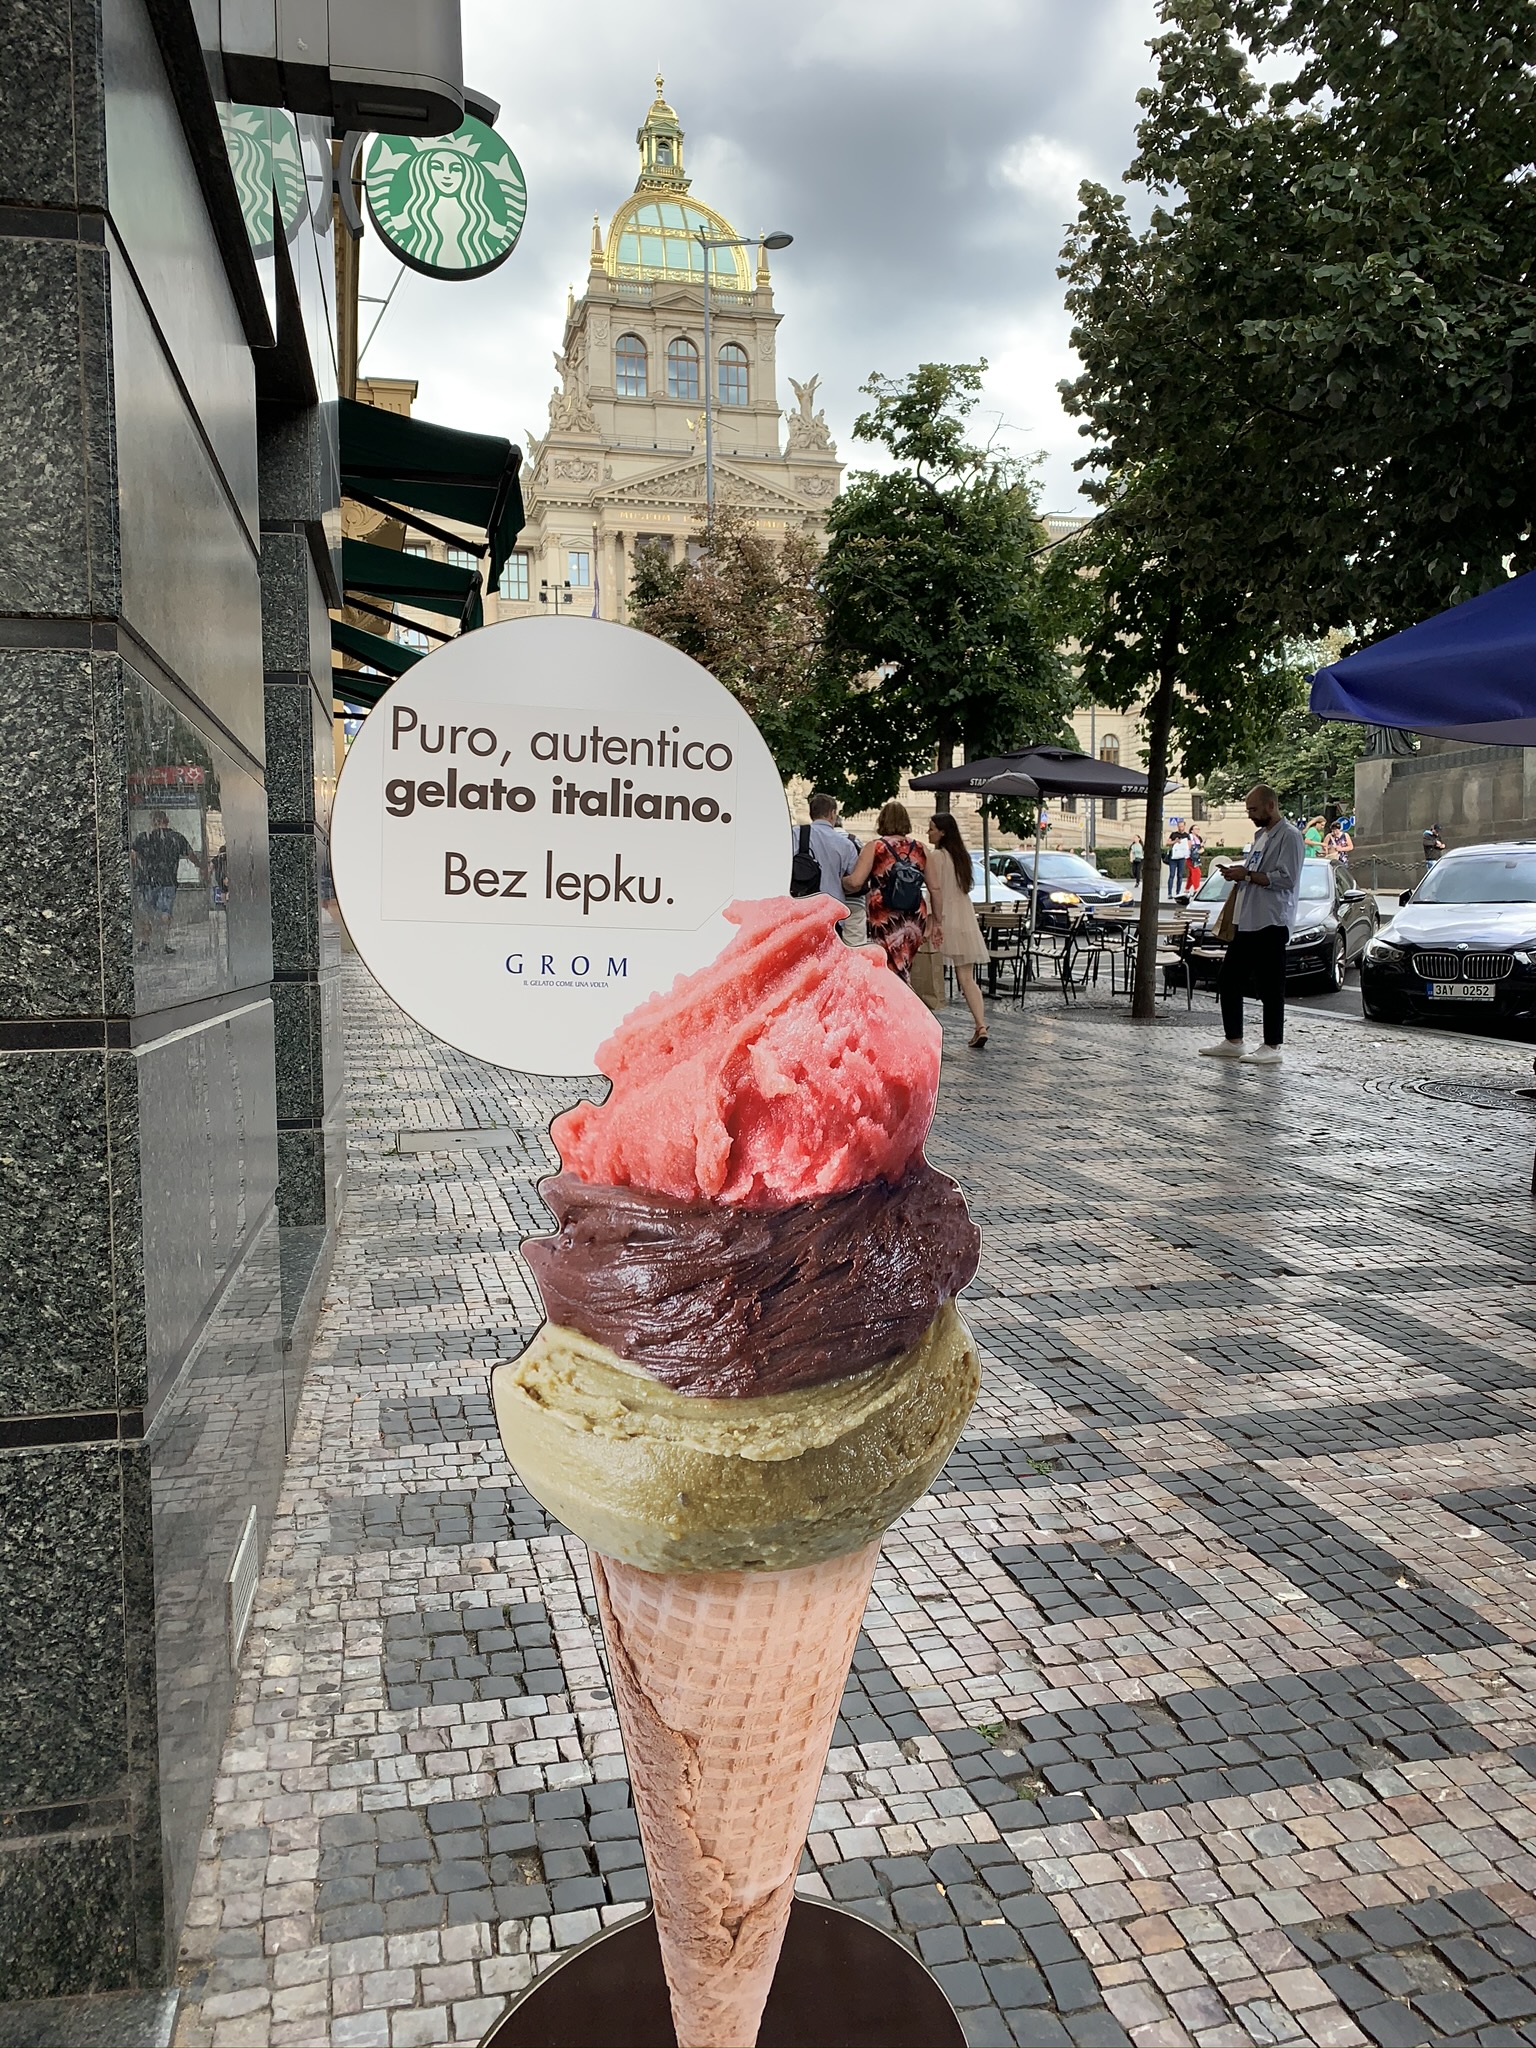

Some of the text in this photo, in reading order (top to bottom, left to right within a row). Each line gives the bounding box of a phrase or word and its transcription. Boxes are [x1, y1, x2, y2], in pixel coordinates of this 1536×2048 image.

[391, 705, 734, 773] Puro, autentico
[385, 767, 733, 825] gelato italiano.
[443, 849, 675, 915] Bez lepku.
[505, 953, 628, 977] GROM
[1435, 985, 1490, 996] 3AY 0252
